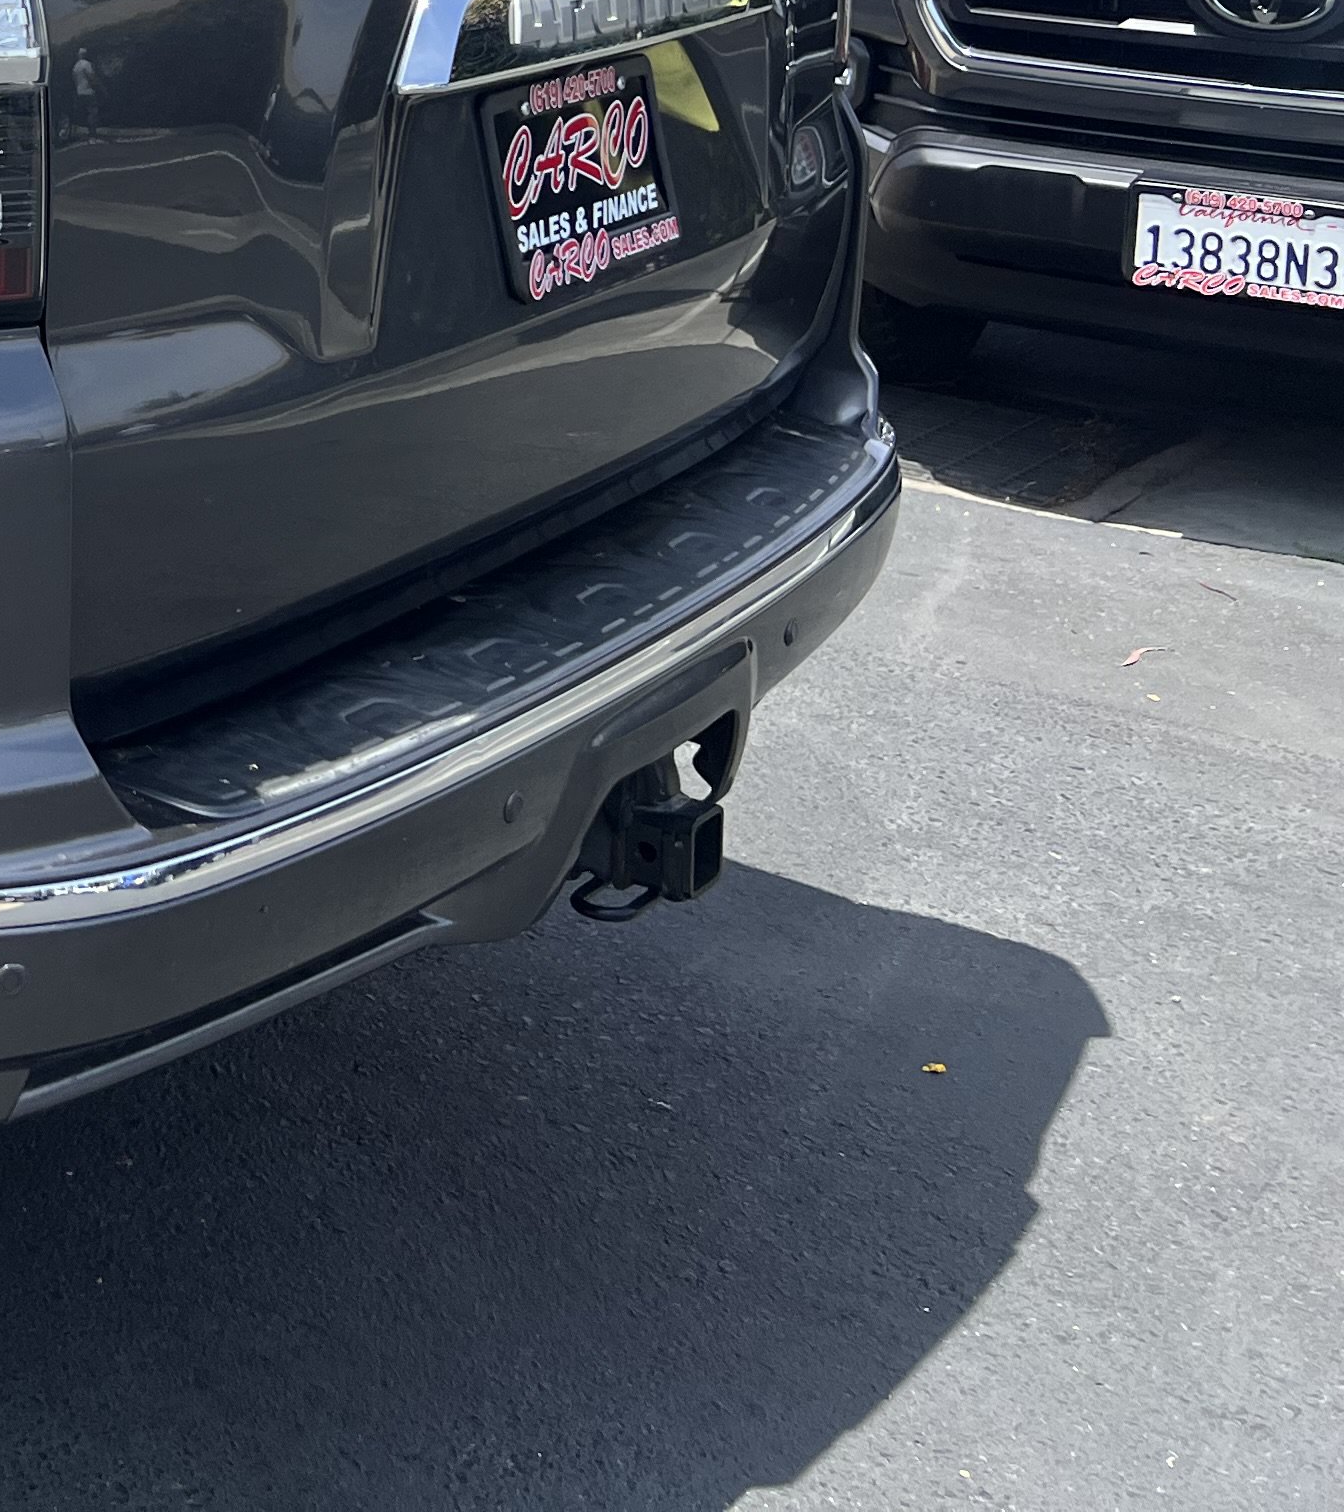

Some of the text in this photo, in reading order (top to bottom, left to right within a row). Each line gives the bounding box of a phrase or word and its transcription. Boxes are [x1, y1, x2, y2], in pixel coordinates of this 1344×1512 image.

[529, 66, 616, 116] (619) 420-5700
[502, 96, 649, 221] CARCO
[516, 183, 659, 254] SALES & FINANCE
[1184, 189, 1304, 219] (619) 420-5700
[529, 216, 680, 301] CARCO SALES.COM
[1132, 263, 1247, 297] CARCO
[1142, 224, 1340, 290] 13838N3
